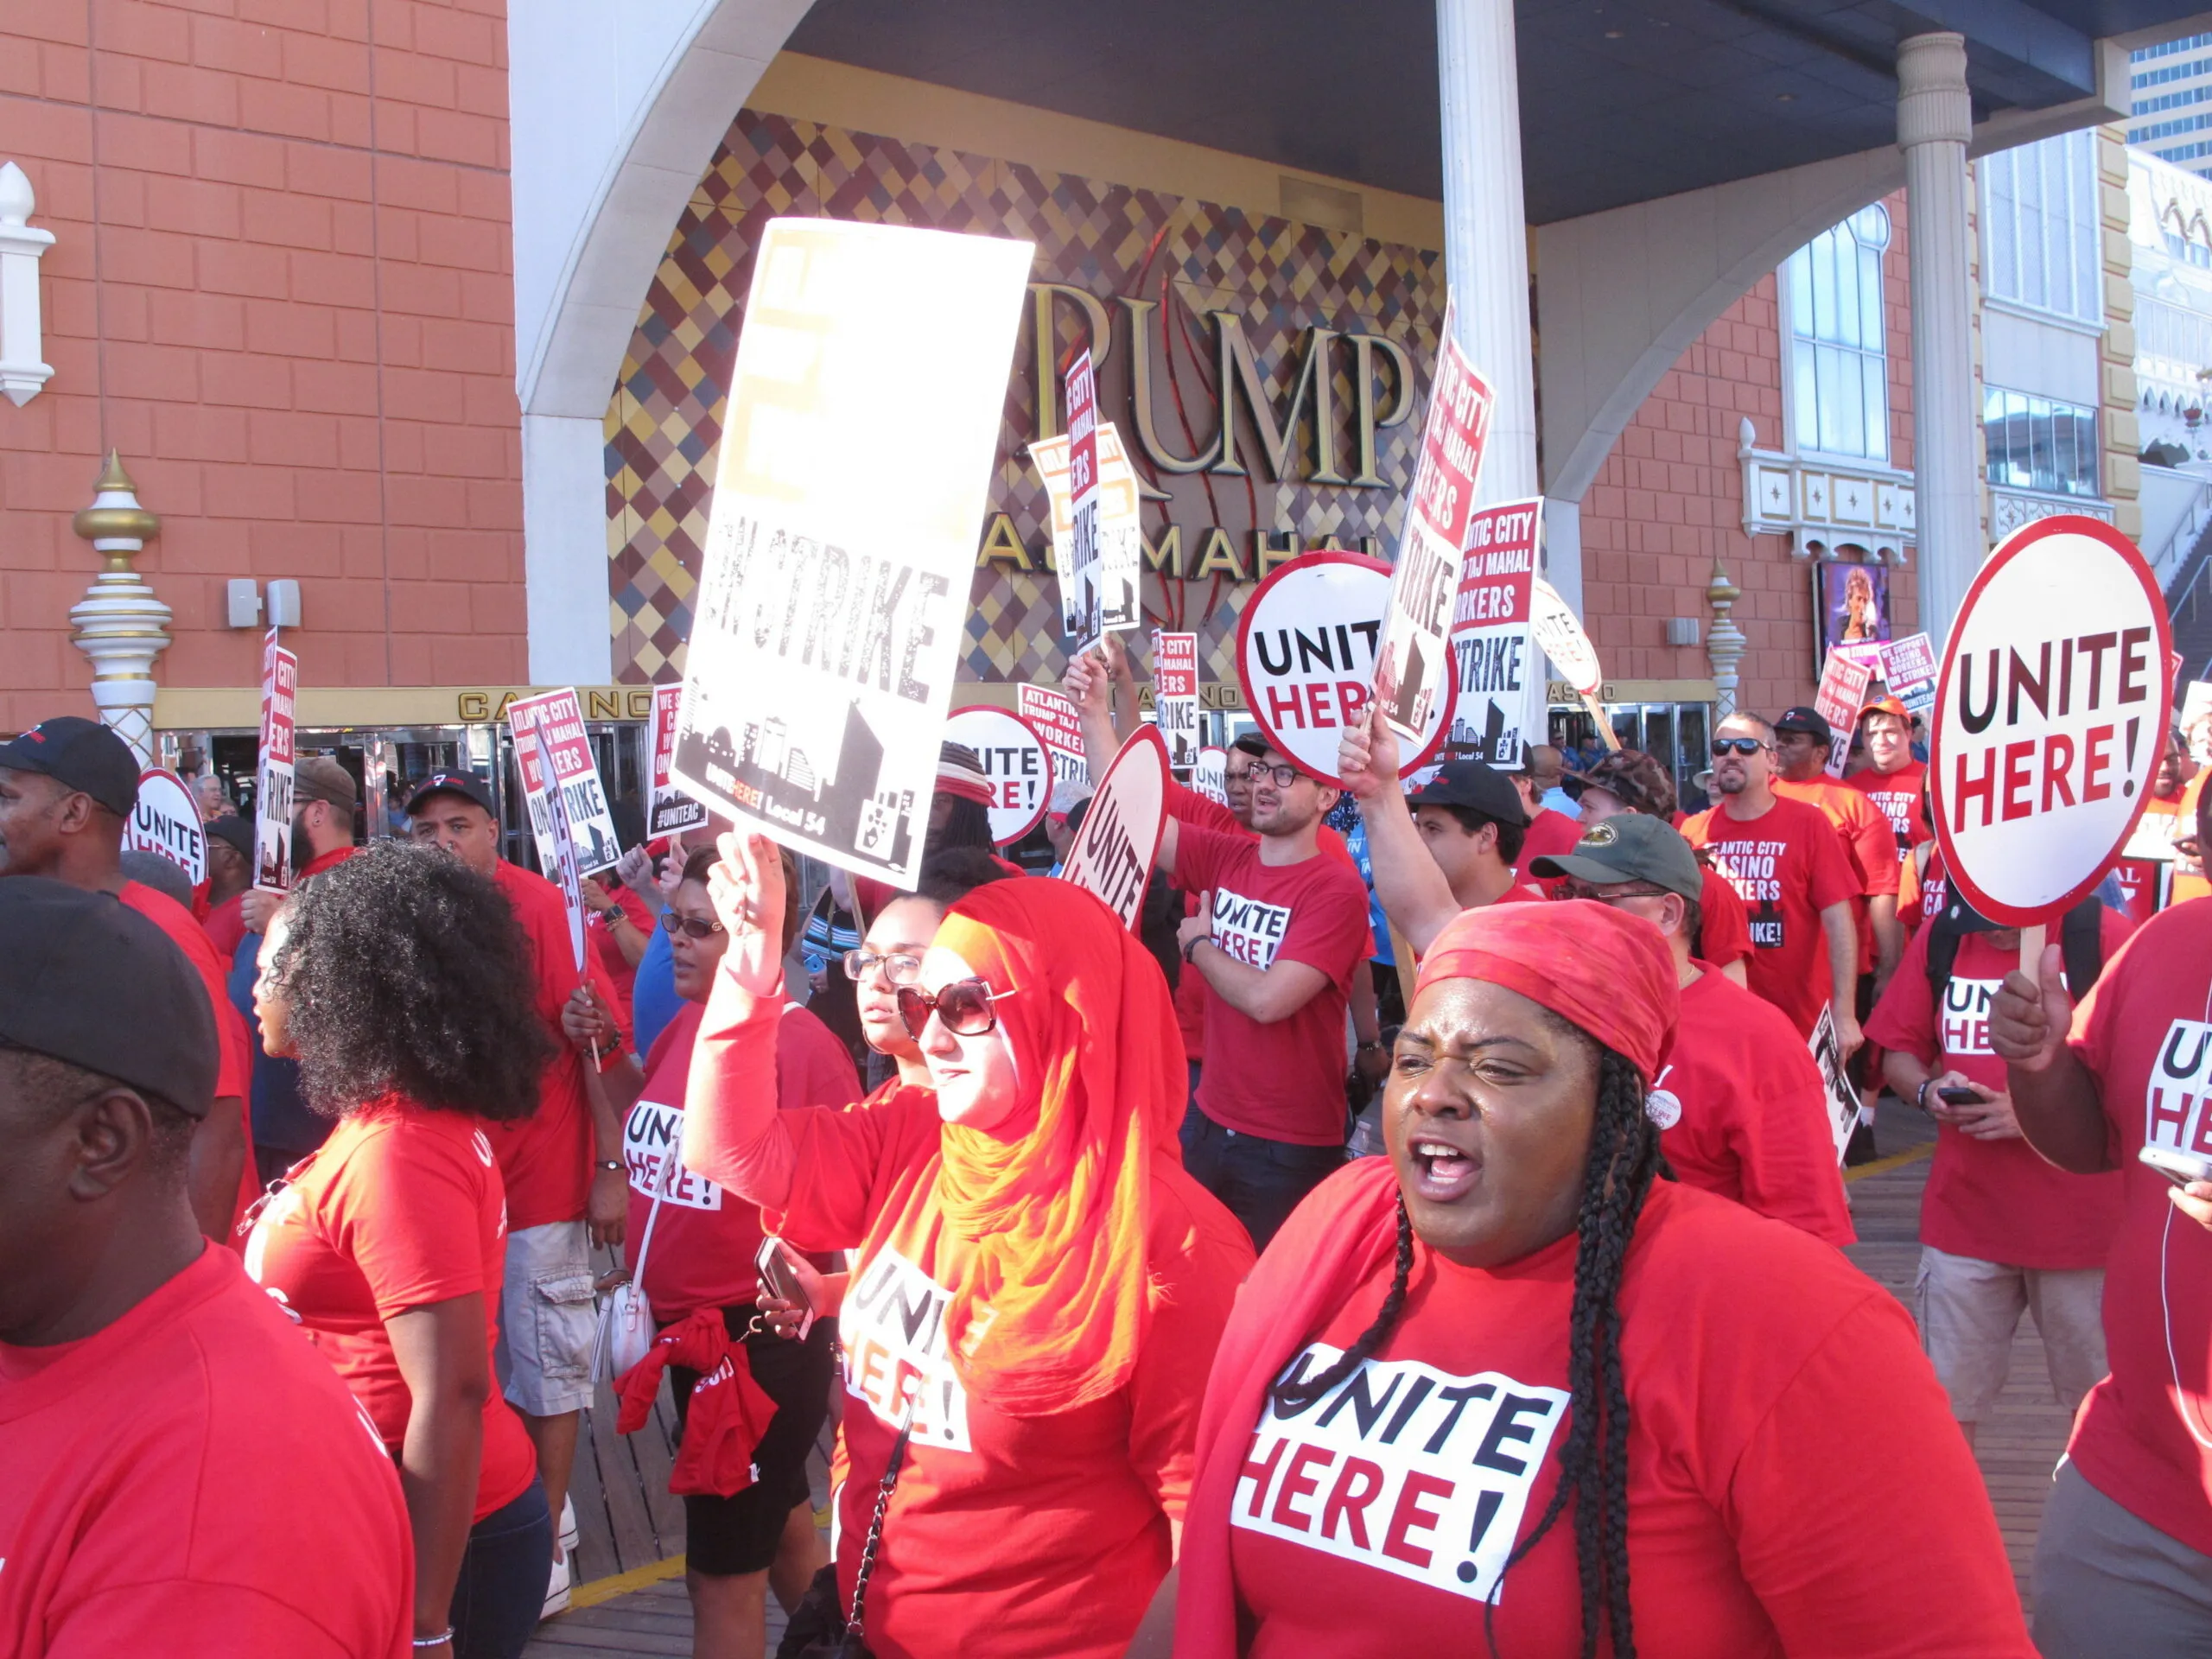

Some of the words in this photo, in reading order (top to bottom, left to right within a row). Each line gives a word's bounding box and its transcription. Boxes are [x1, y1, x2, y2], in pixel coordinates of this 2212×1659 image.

[1018, 282, 1415, 501] RUMP
[1072, 366, 1090, 410] CITY
[1455, 378, 1488, 438] CITY
[1442, 428, 1477, 483] MAHAL
[1072, 500, 1099, 574] RIKE
[1495, 512, 1534, 543] CITY
[1485, 548, 1532, 576] MAHAL
[1399, 526, 1454, 639] TRIKE
[1454, 584, 1515, 624] ORKERS
[1166, 639, 1192, 655] CITY
[1255, 620, 1381, 677] UNIT
[1890, 649, 1922, 666] CASINO
[277, 660, 296, 691] CITY
[1163, 658, 1194, 671] MAHAL
[1843, 666, 1866, 689] CITY
[1889, 658, 1927, 676] WORKERS
[1889, 677, 1902, 688] ON
[1903, 665, 1935, 684] STRIKE!
[1959, 626, 2152, 734] UNITE
[550, 697, 575, 724] CITY
[659, 694, 672, 710] WE
[1023, 702, 1056, 722] TRUMP
[1058, 714, 1075, 730] TAJ
[1165, 702, 1195, 729] RIKE
[1266, 681, 1367, 730] HER
[554, 721, 583, 742] MAHAL
[1033, 720, 1085, 753] WORKE
[527, 747, 583, 784] WOKERS
[974, 747, 1039, 775] ITE
[1051, 750, 1092, 785] STRI
[1954, 715, 2141, 835] HERE!
[988, 779, 1035, 810] RE!
[1197, 767, 1223, 790] UNI
[267, 768, 292, 826] RIKE
[563, 779, 605, 824] RIKE
[1894, 791, 1916, 804] CITY
[136, 801, 200, 861] UNITE
[658, 803, 699, 829] #UNITEAC
[766, 795, 804, 827] Local
[803, 814, 826, 836] 54
[1087, 783, 1145, 926] UNITE
[1758, 841, 1786, 856] CITY
[1750, 922, 1782, 943] IKE!
[855, 1262, 945, 1357] UNI
[1274, 1352, 1554, 1477] UNITE
[1241, 1433, 1504, 1584] HERE!
